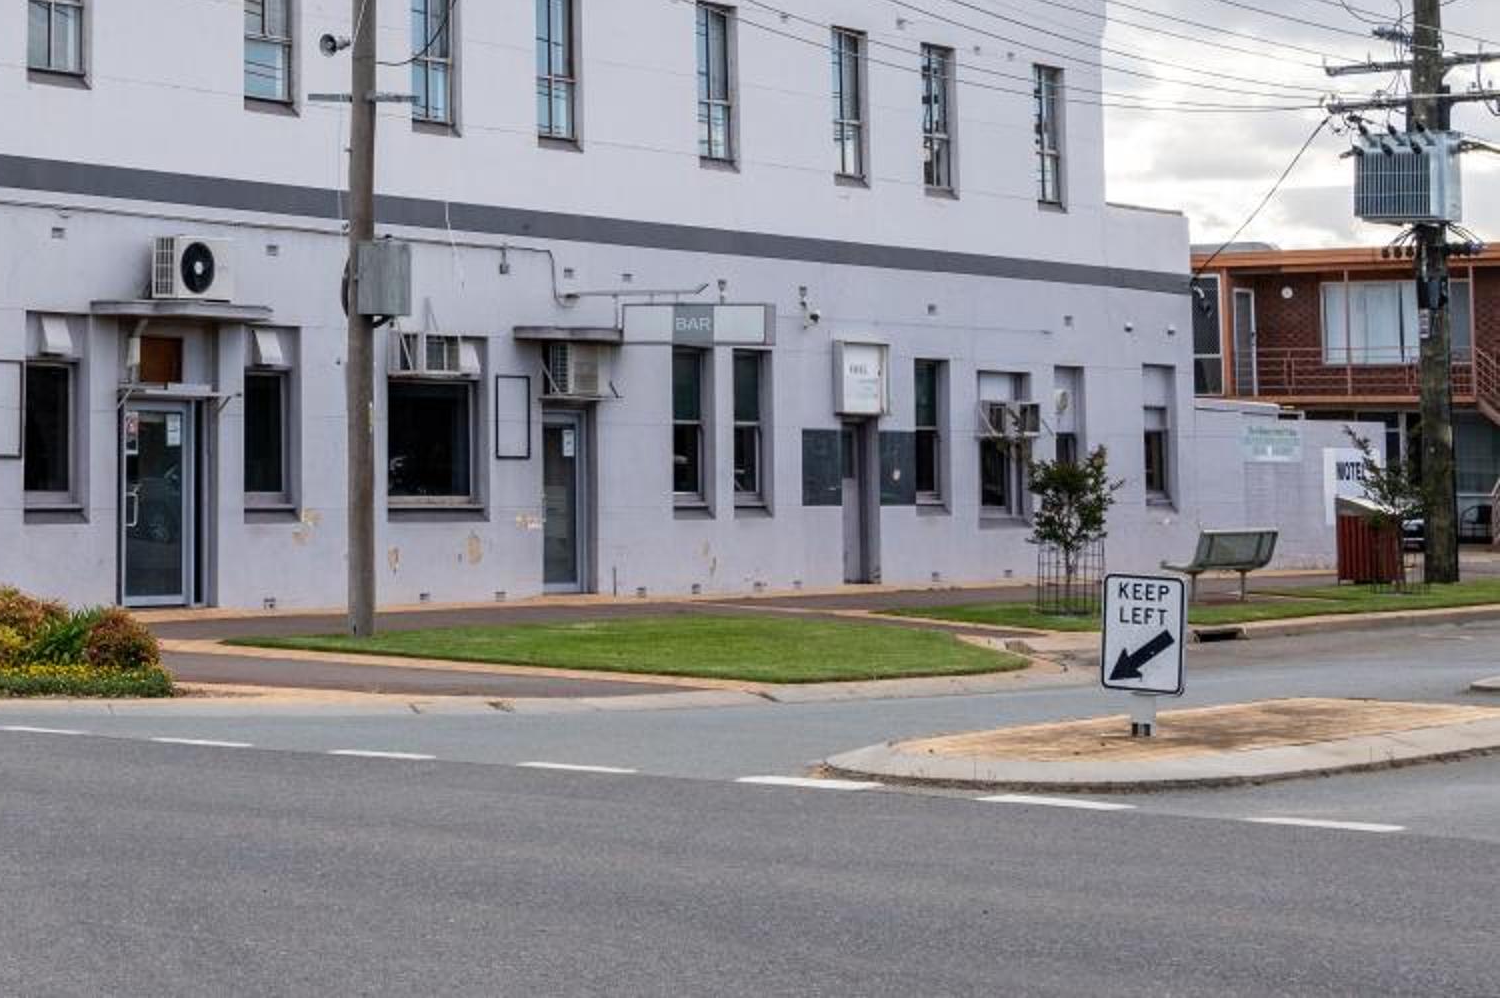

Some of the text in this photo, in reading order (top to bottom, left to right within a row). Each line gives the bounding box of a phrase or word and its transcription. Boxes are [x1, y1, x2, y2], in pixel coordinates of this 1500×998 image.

[675, 317, 710, 331] BAR
[1118, 581, 1170, 602] KEEP
[1119, 606, 1169, 626] LEFT
